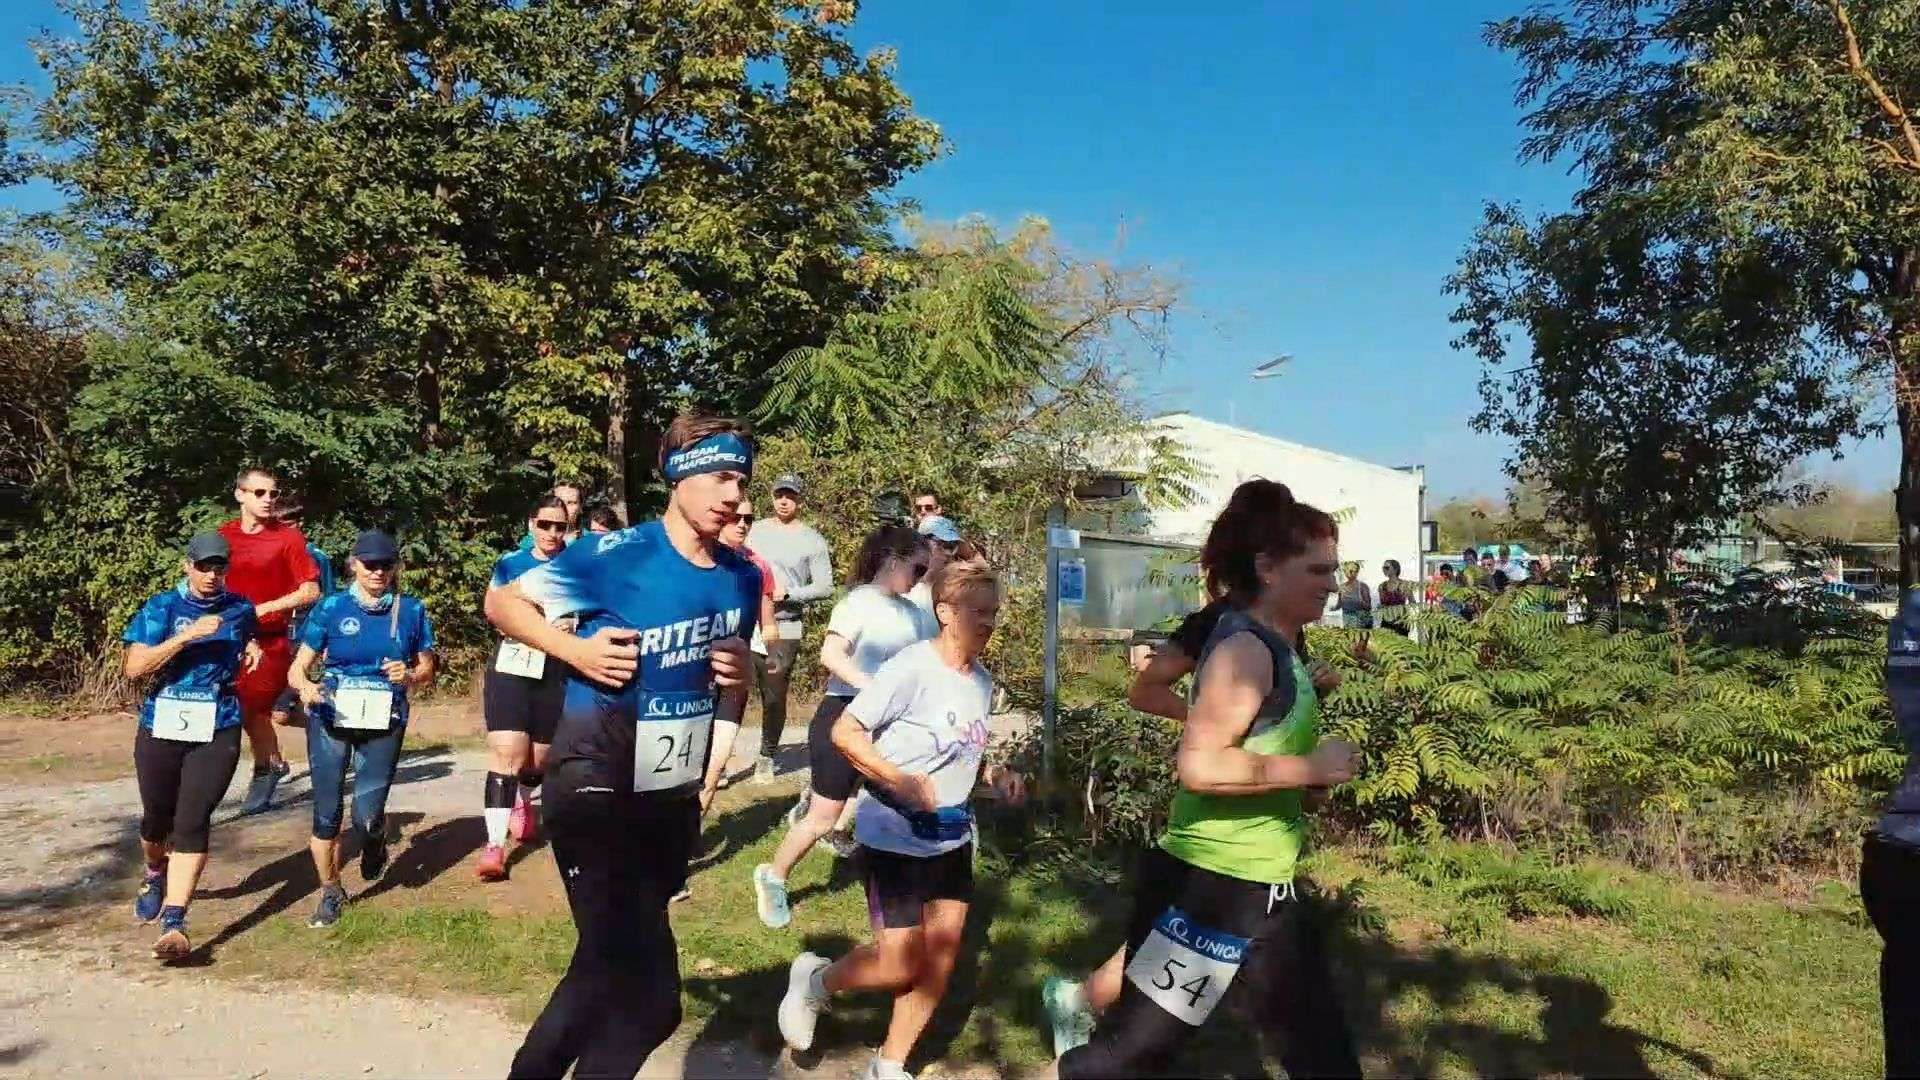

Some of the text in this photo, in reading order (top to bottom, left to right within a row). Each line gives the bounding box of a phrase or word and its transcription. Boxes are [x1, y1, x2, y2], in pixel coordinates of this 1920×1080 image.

[639, 608, 741, 656] RITEAM
[660, 644, 711, 669] MARC
[176, 710, 192, 731] 5
[361, 698, 367, 719] 1
[652, 732, 693, 774] 24
[1151, 959, 1211, 1008] 54
